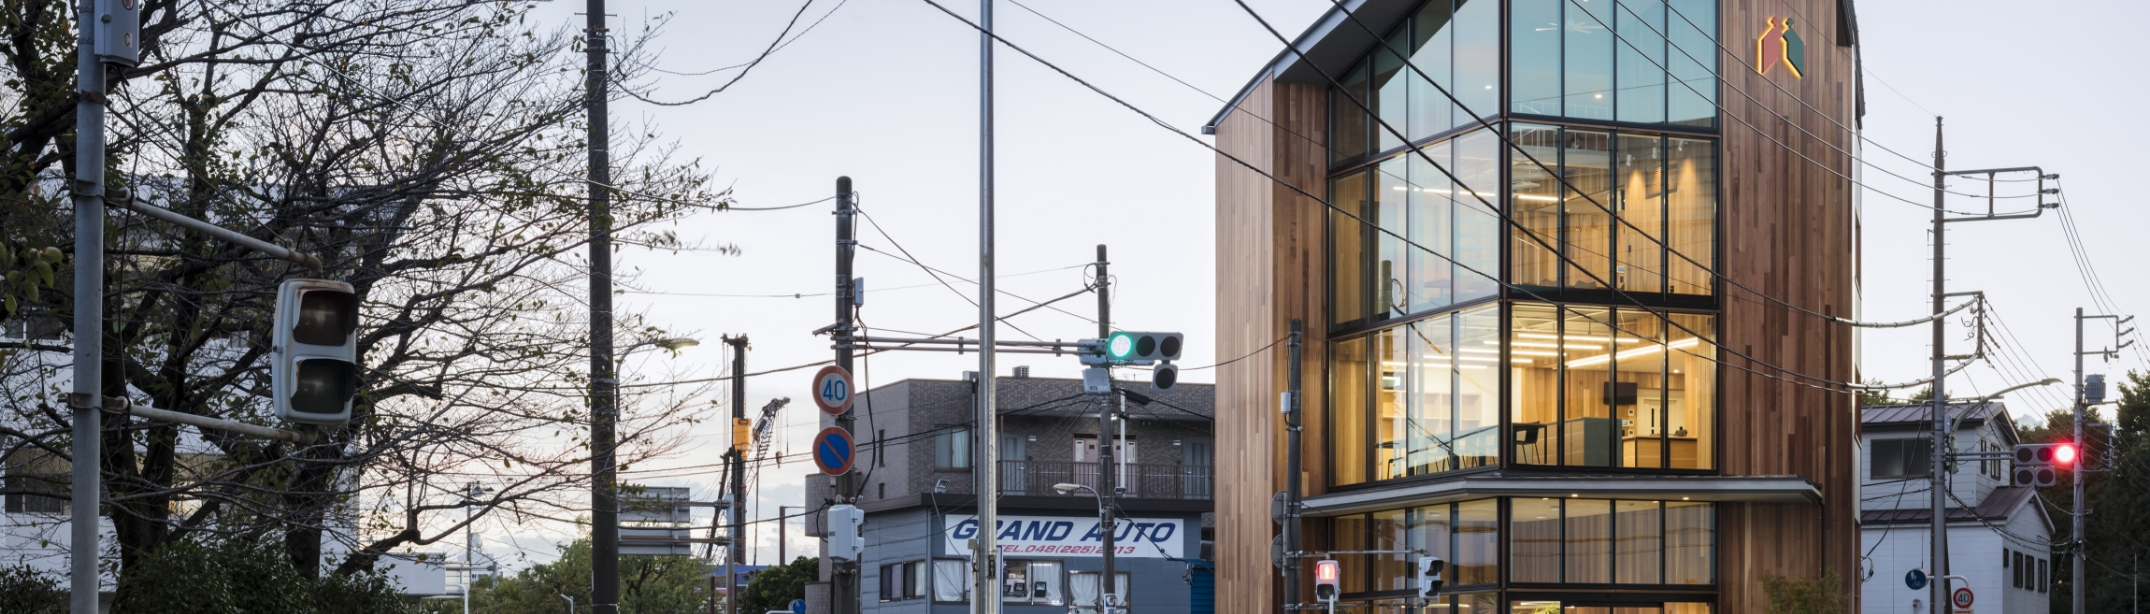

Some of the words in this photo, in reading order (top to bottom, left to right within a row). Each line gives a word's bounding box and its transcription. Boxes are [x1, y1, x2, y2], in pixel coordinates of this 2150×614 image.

[823, 379, 845, 401] 40
[952, 519, 1074, 541] GAND
[1958, 593, 1970, 602] 40
